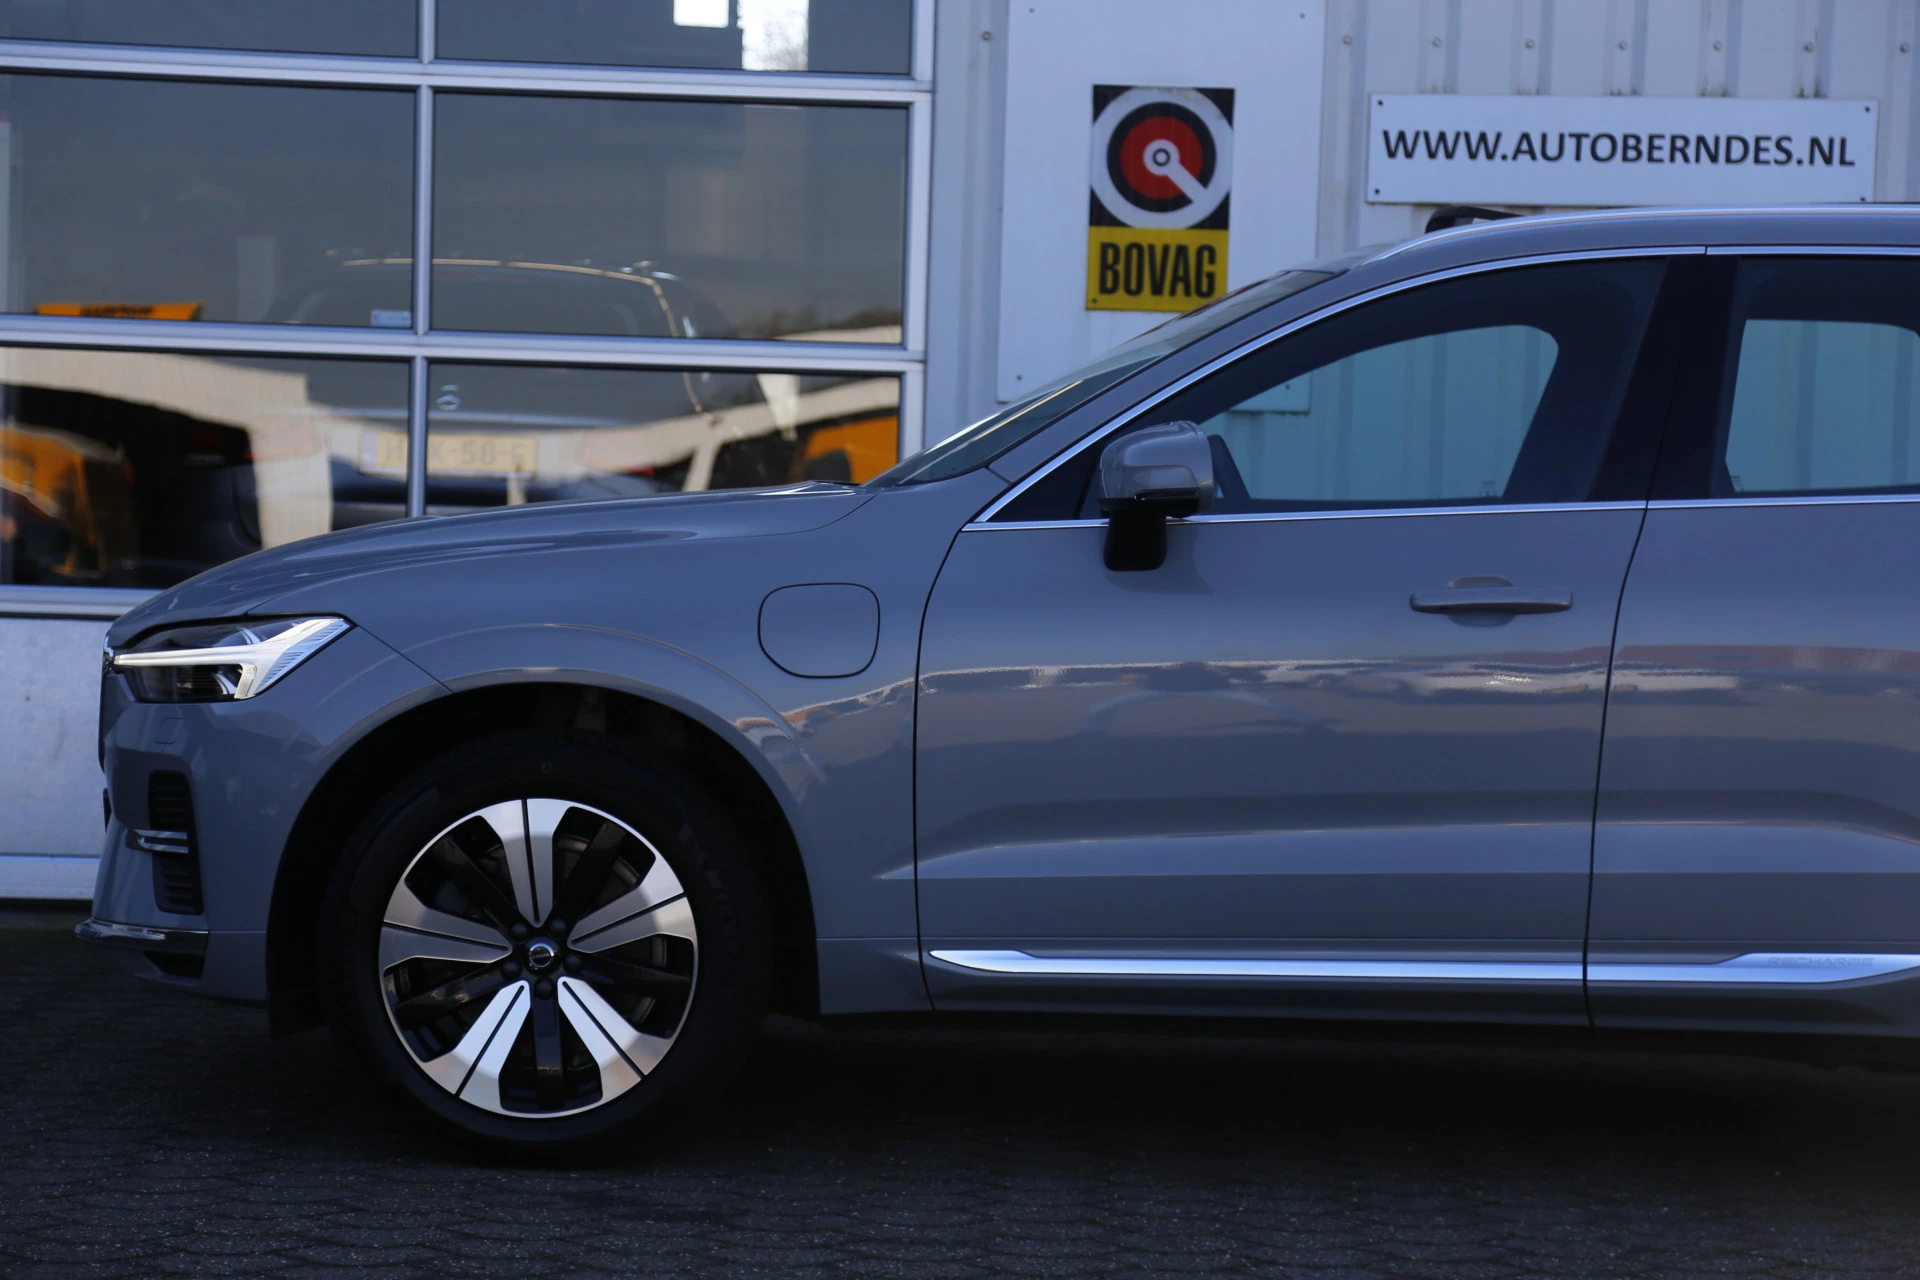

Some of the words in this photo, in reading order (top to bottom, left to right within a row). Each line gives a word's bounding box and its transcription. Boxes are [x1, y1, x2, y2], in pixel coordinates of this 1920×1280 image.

[1382, 129, 1856, 167] WWW.AUTOBERNDES.NL
[1099, 241, 1217, 299] BOVAG
[1767, 956, 1875, 968] RECHARGE
